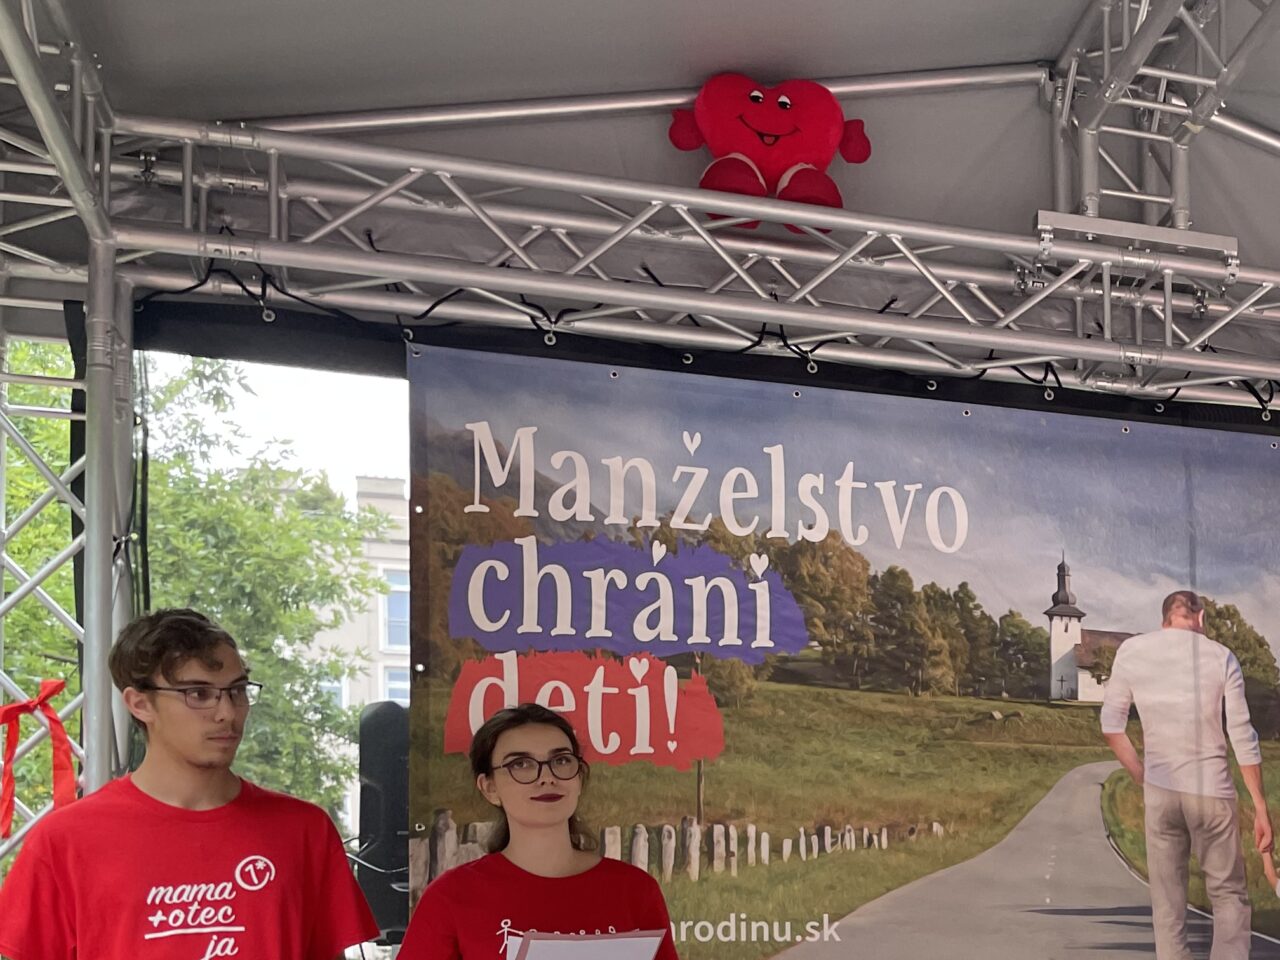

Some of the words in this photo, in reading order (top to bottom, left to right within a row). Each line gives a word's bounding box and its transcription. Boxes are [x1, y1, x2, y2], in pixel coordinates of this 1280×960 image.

[463, 421, 970, 554] Manželstvo
[466, 535, 776, 649] chráni
[146, 881, 236, 905] mama
